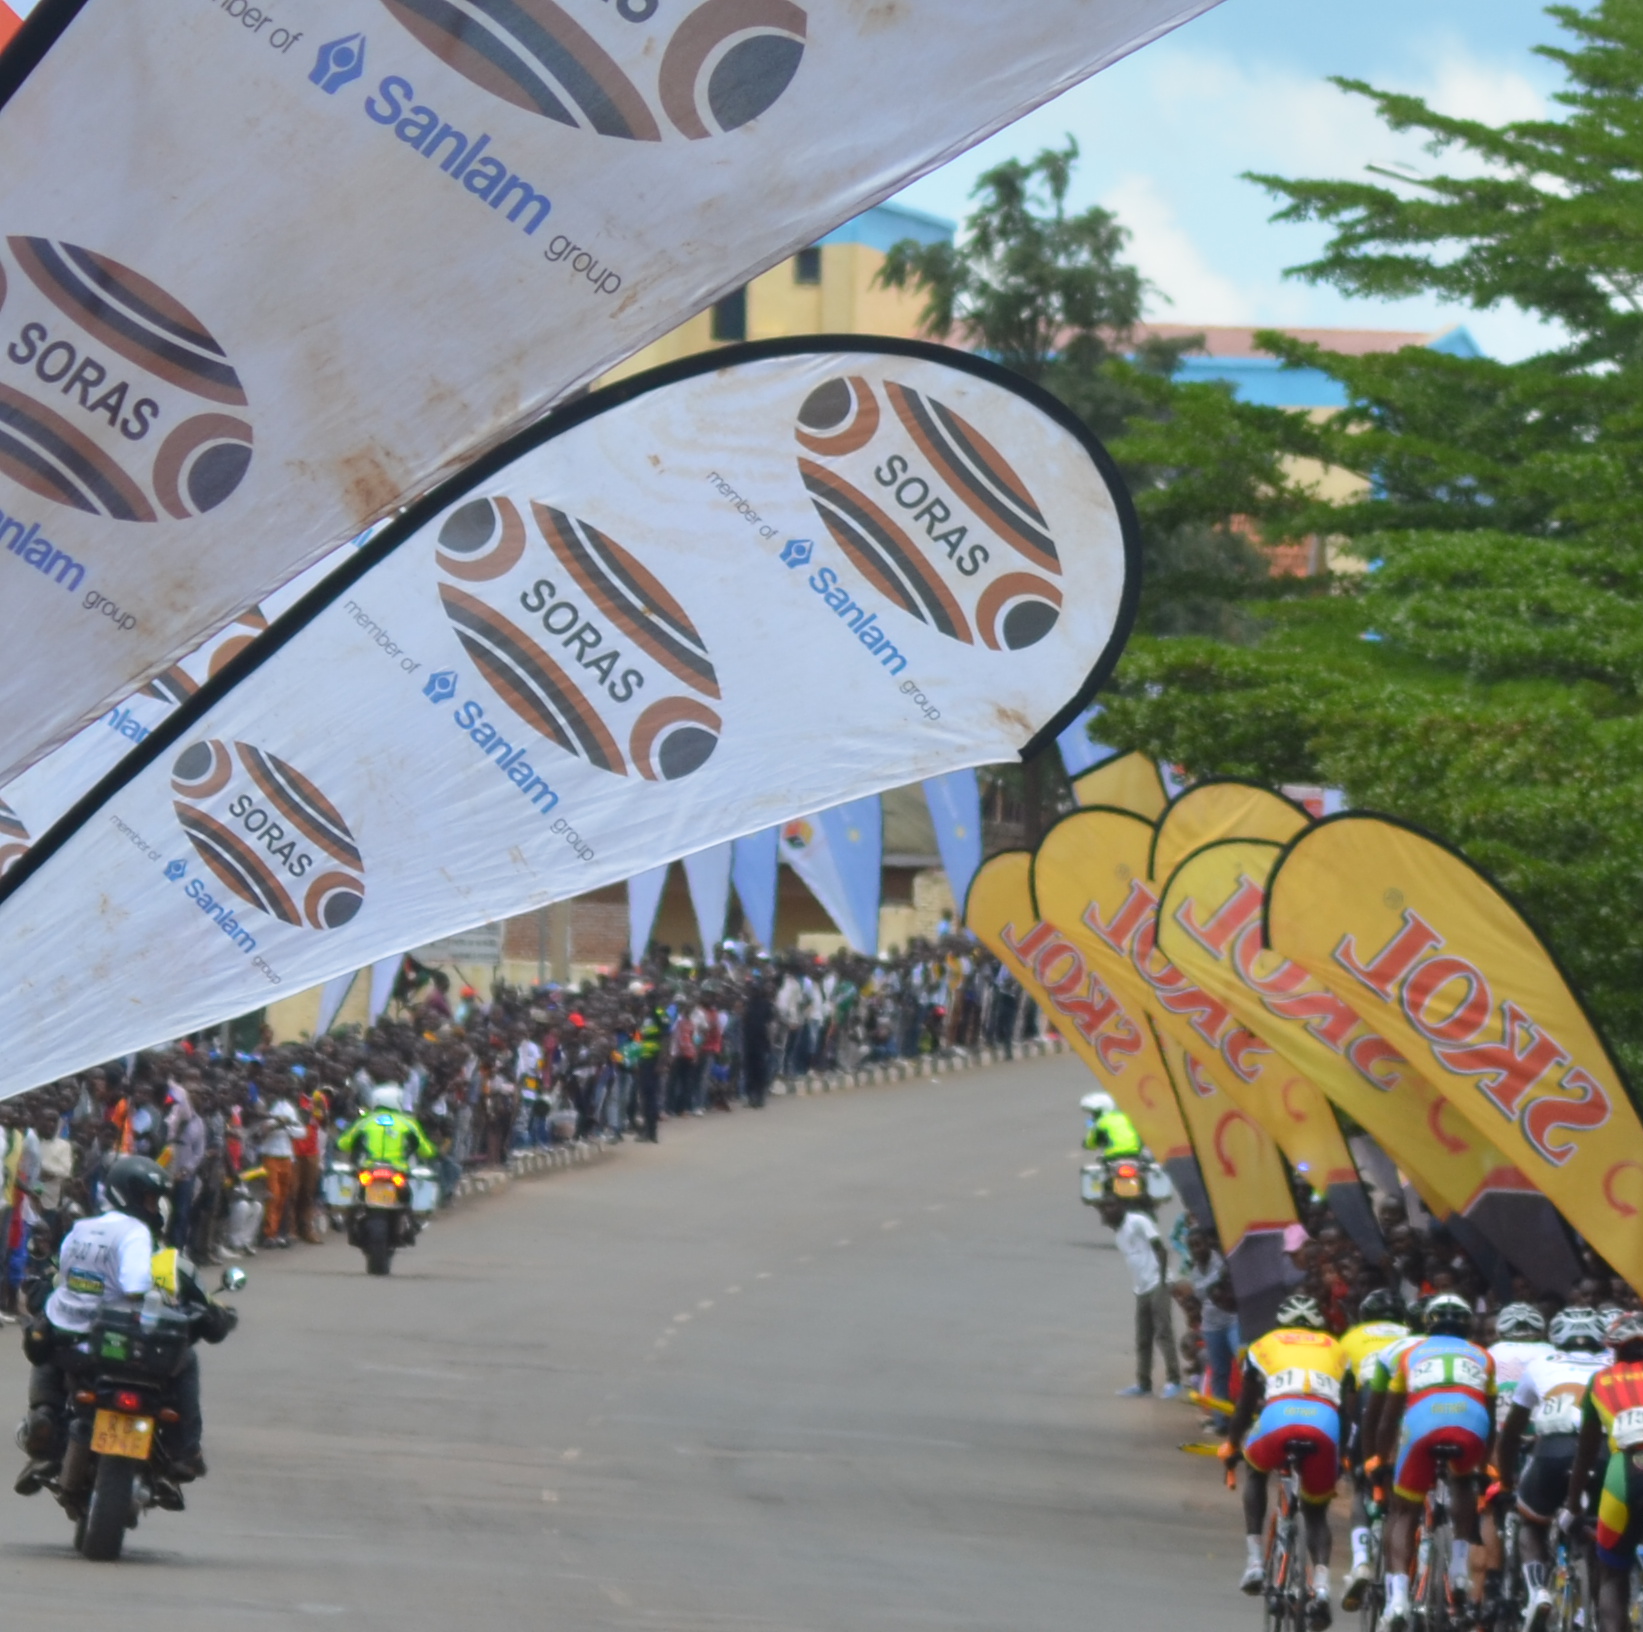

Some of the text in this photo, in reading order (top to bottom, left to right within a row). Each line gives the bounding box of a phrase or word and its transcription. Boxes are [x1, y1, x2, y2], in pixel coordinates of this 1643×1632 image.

[268, 29, 304, 54] of
[364, 74, 552, 236] Sanlam
[543, 233, 622, 295] group
[7, 321, 160, 441] SORAS
[706, 470, 779, 540] member of
[874, 454, 990, 577] SORAS
[0, 508, 86, 592] nlam
[82, 589, 137, 631] group
[343, 599, 421, 675] member of
[519, 578, 645, 703] SORAS
[808, 566, 907, 676] Sanlam
[898, 678, 941, 721] group
[453, 700, 559, 815] Sanlam
[228, 794, 313, 878] SORAS
[550, 816, 595, 862] group
[184, 877, 257, 953] Sanlam
